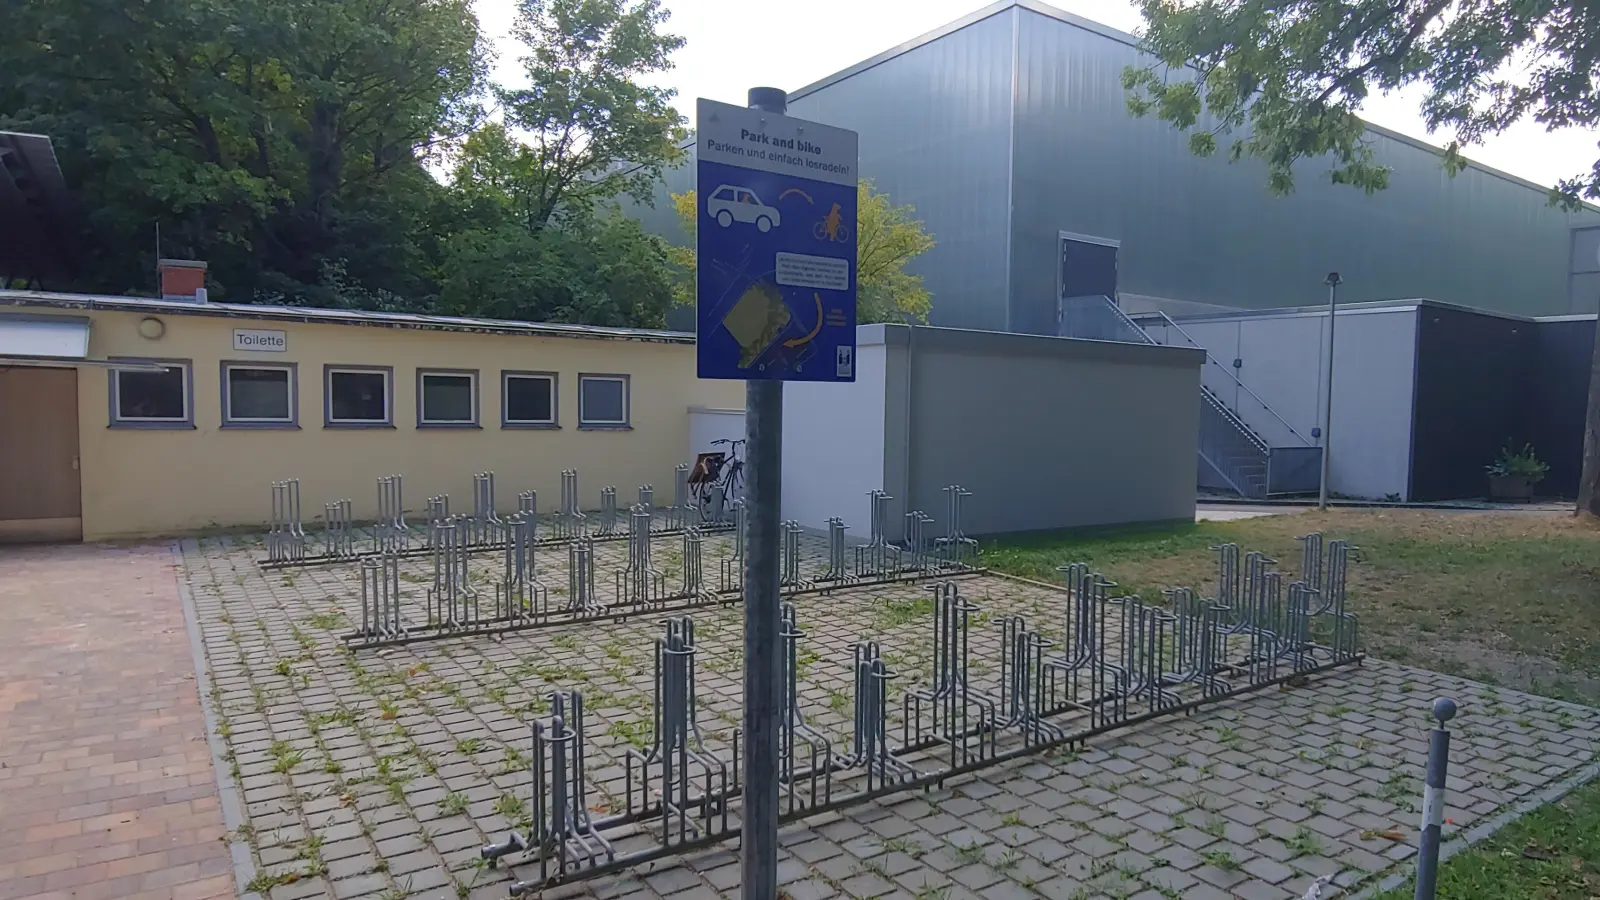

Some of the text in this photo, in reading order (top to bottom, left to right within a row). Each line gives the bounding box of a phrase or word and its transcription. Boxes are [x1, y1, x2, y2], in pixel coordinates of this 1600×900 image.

[741, 128, 822, 155] Park and bike
[707, 139, 849, 175] Parken und einfach losradeln!
[236, 334, 284, 346] Toilette
